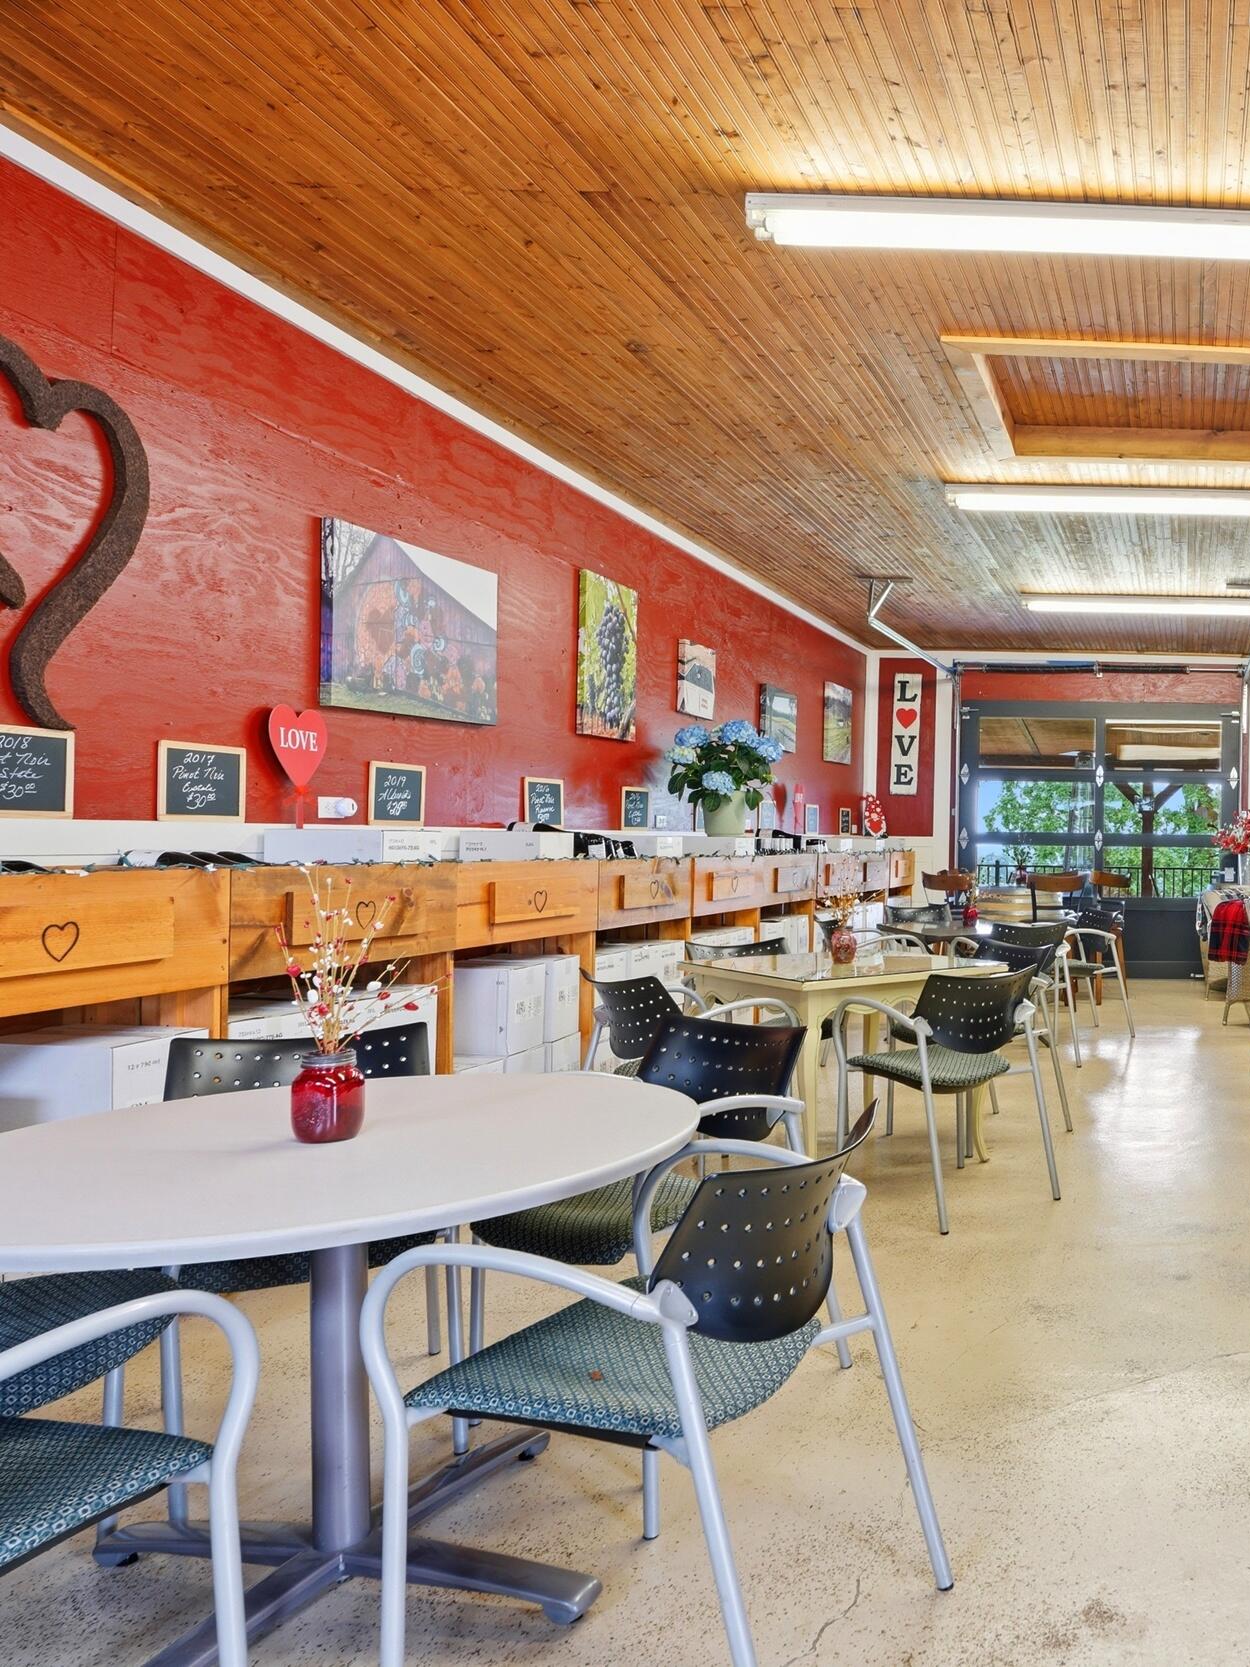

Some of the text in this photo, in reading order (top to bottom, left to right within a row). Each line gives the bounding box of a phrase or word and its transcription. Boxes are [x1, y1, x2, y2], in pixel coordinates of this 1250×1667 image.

[280, 727, 318, 752] LOVE
[184, 753, 216, 767] 2017
[0, 766, 44, 779] state
[172, 766, 201, 780] Pinot
[384, 775, 407, 788] 2019
